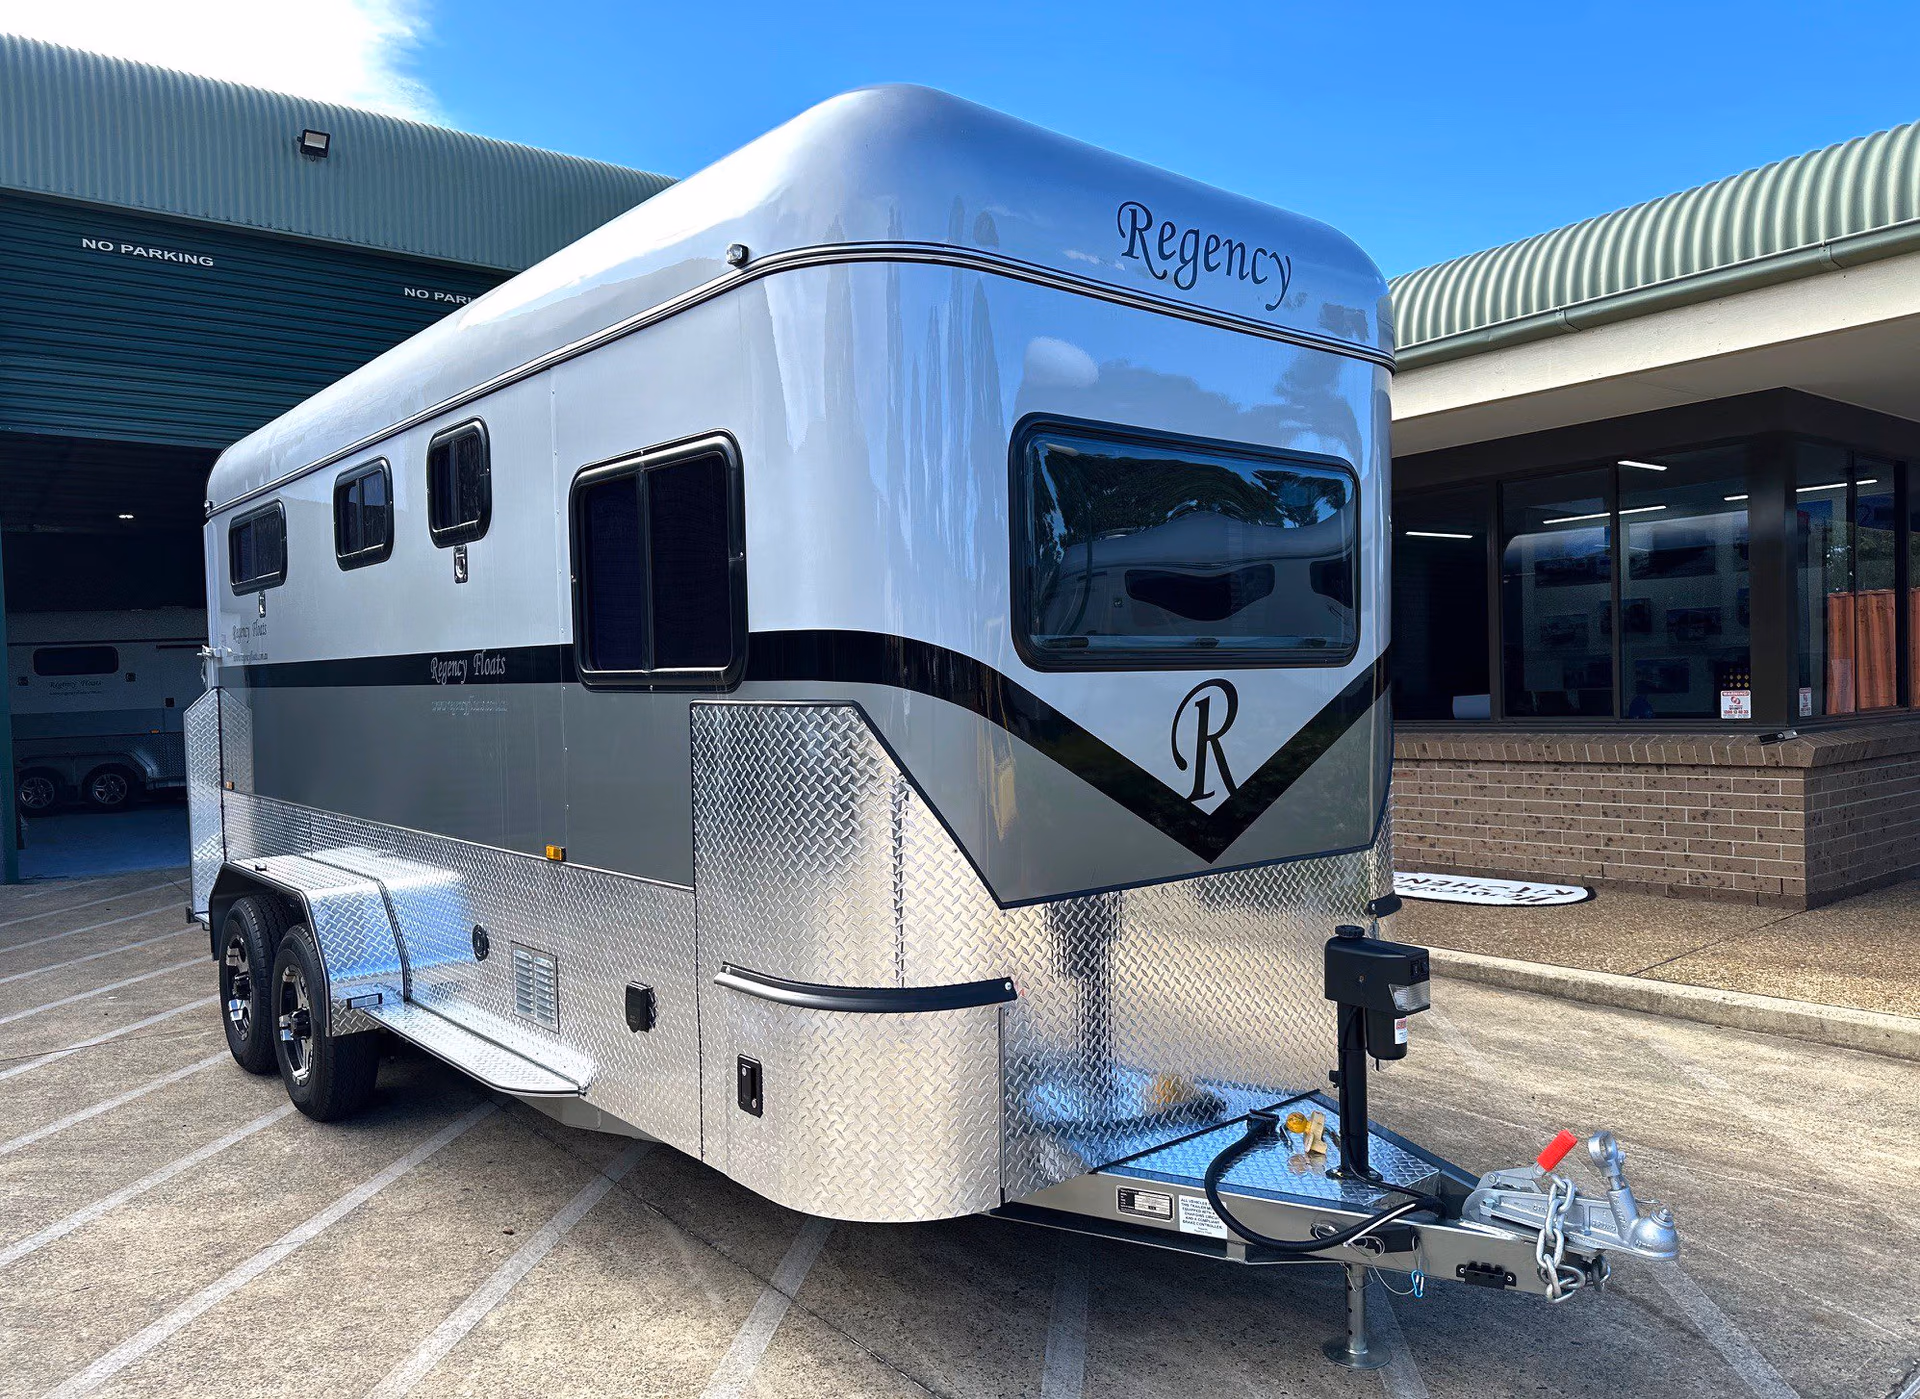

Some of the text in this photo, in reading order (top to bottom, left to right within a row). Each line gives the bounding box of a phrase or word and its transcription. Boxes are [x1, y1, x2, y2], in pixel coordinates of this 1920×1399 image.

[82, 238, 214, 267] NO PARKING
[1117, 201, 1292, 312] Regency
[404, 287, 429, 299] NO
[430, 649, 506, 686] Regency Floats
[1171, 678, 1241, 802] R
